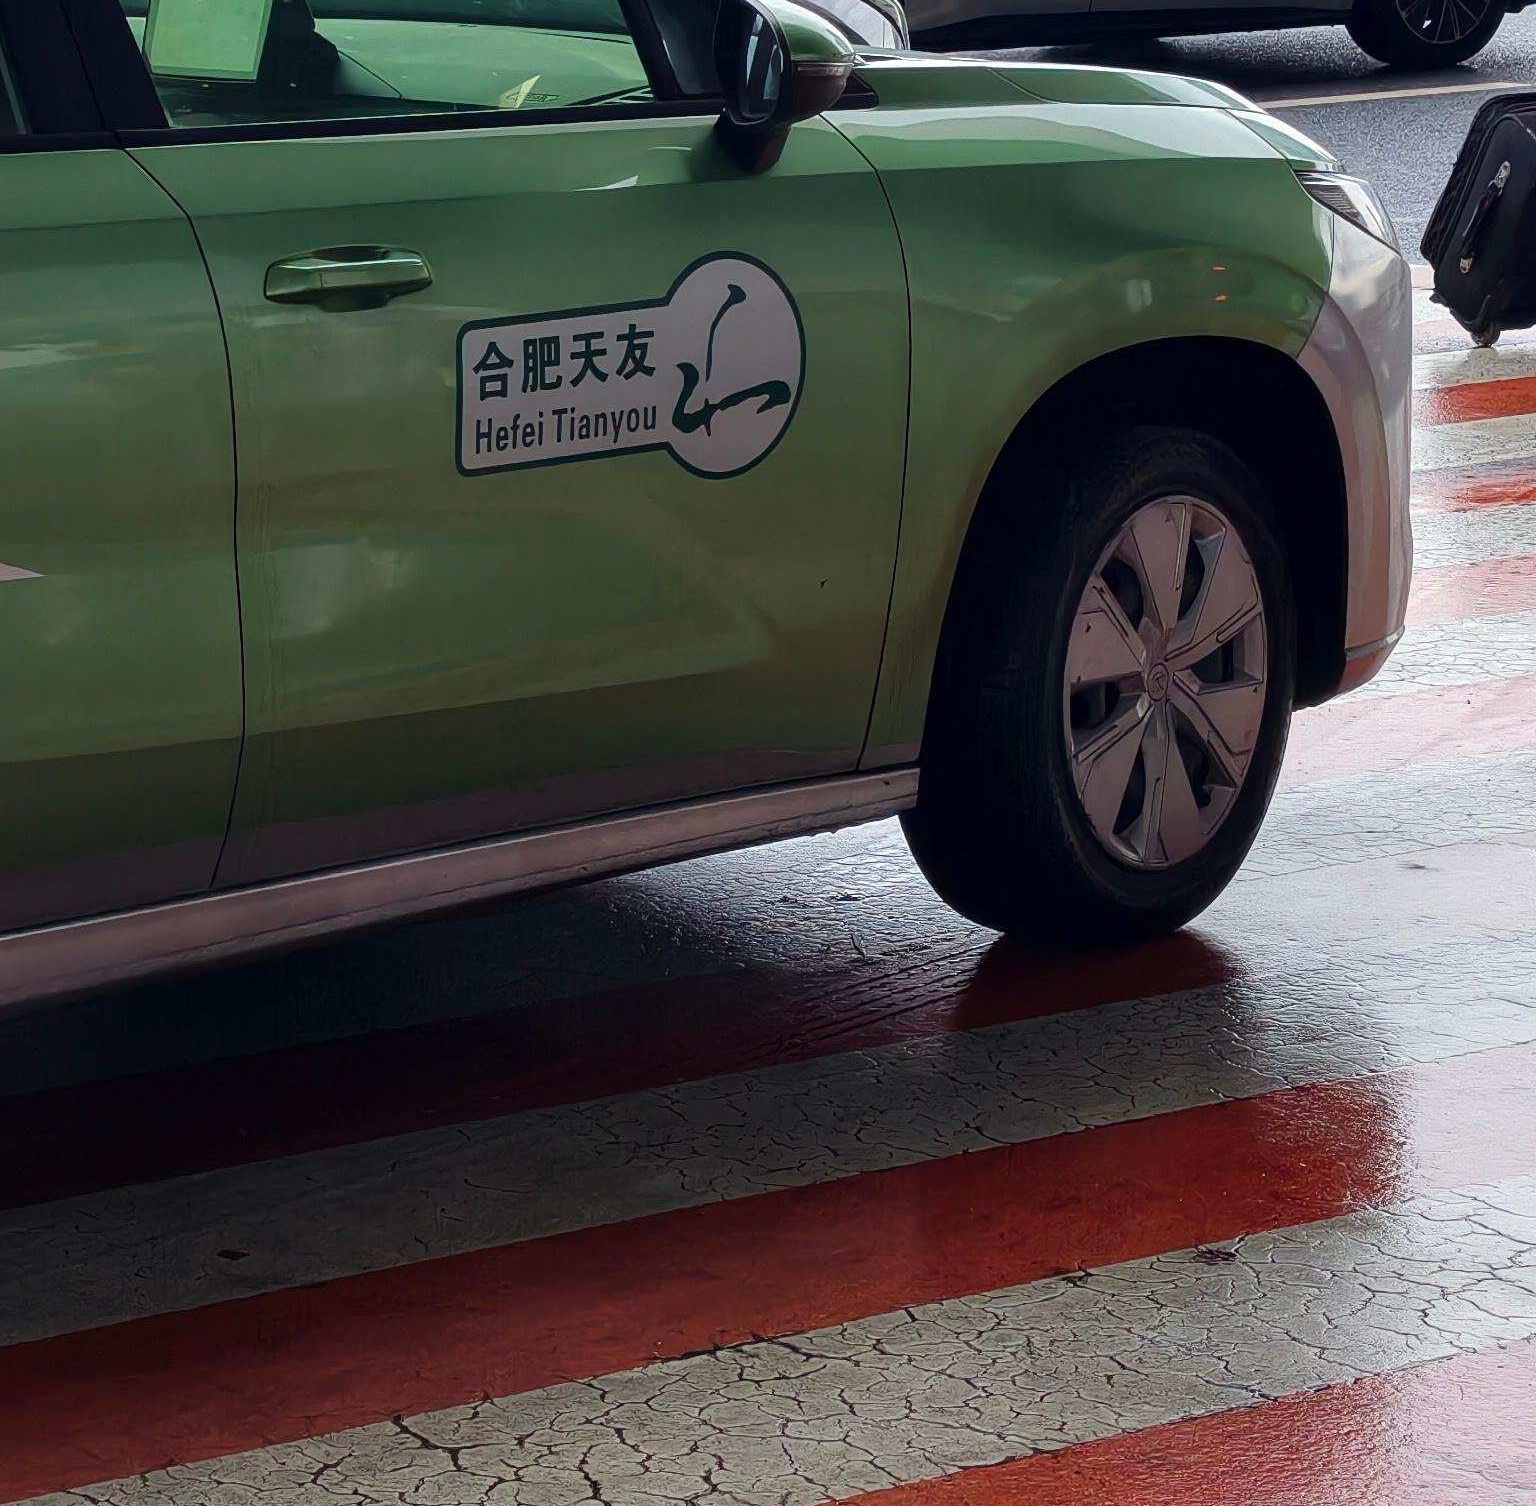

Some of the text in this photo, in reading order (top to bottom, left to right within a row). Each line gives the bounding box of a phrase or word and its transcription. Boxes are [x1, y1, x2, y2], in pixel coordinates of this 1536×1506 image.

[472, 323, 657, 401] 合肥天友
[475, 405, 657, 455] Hefei Tianyou
